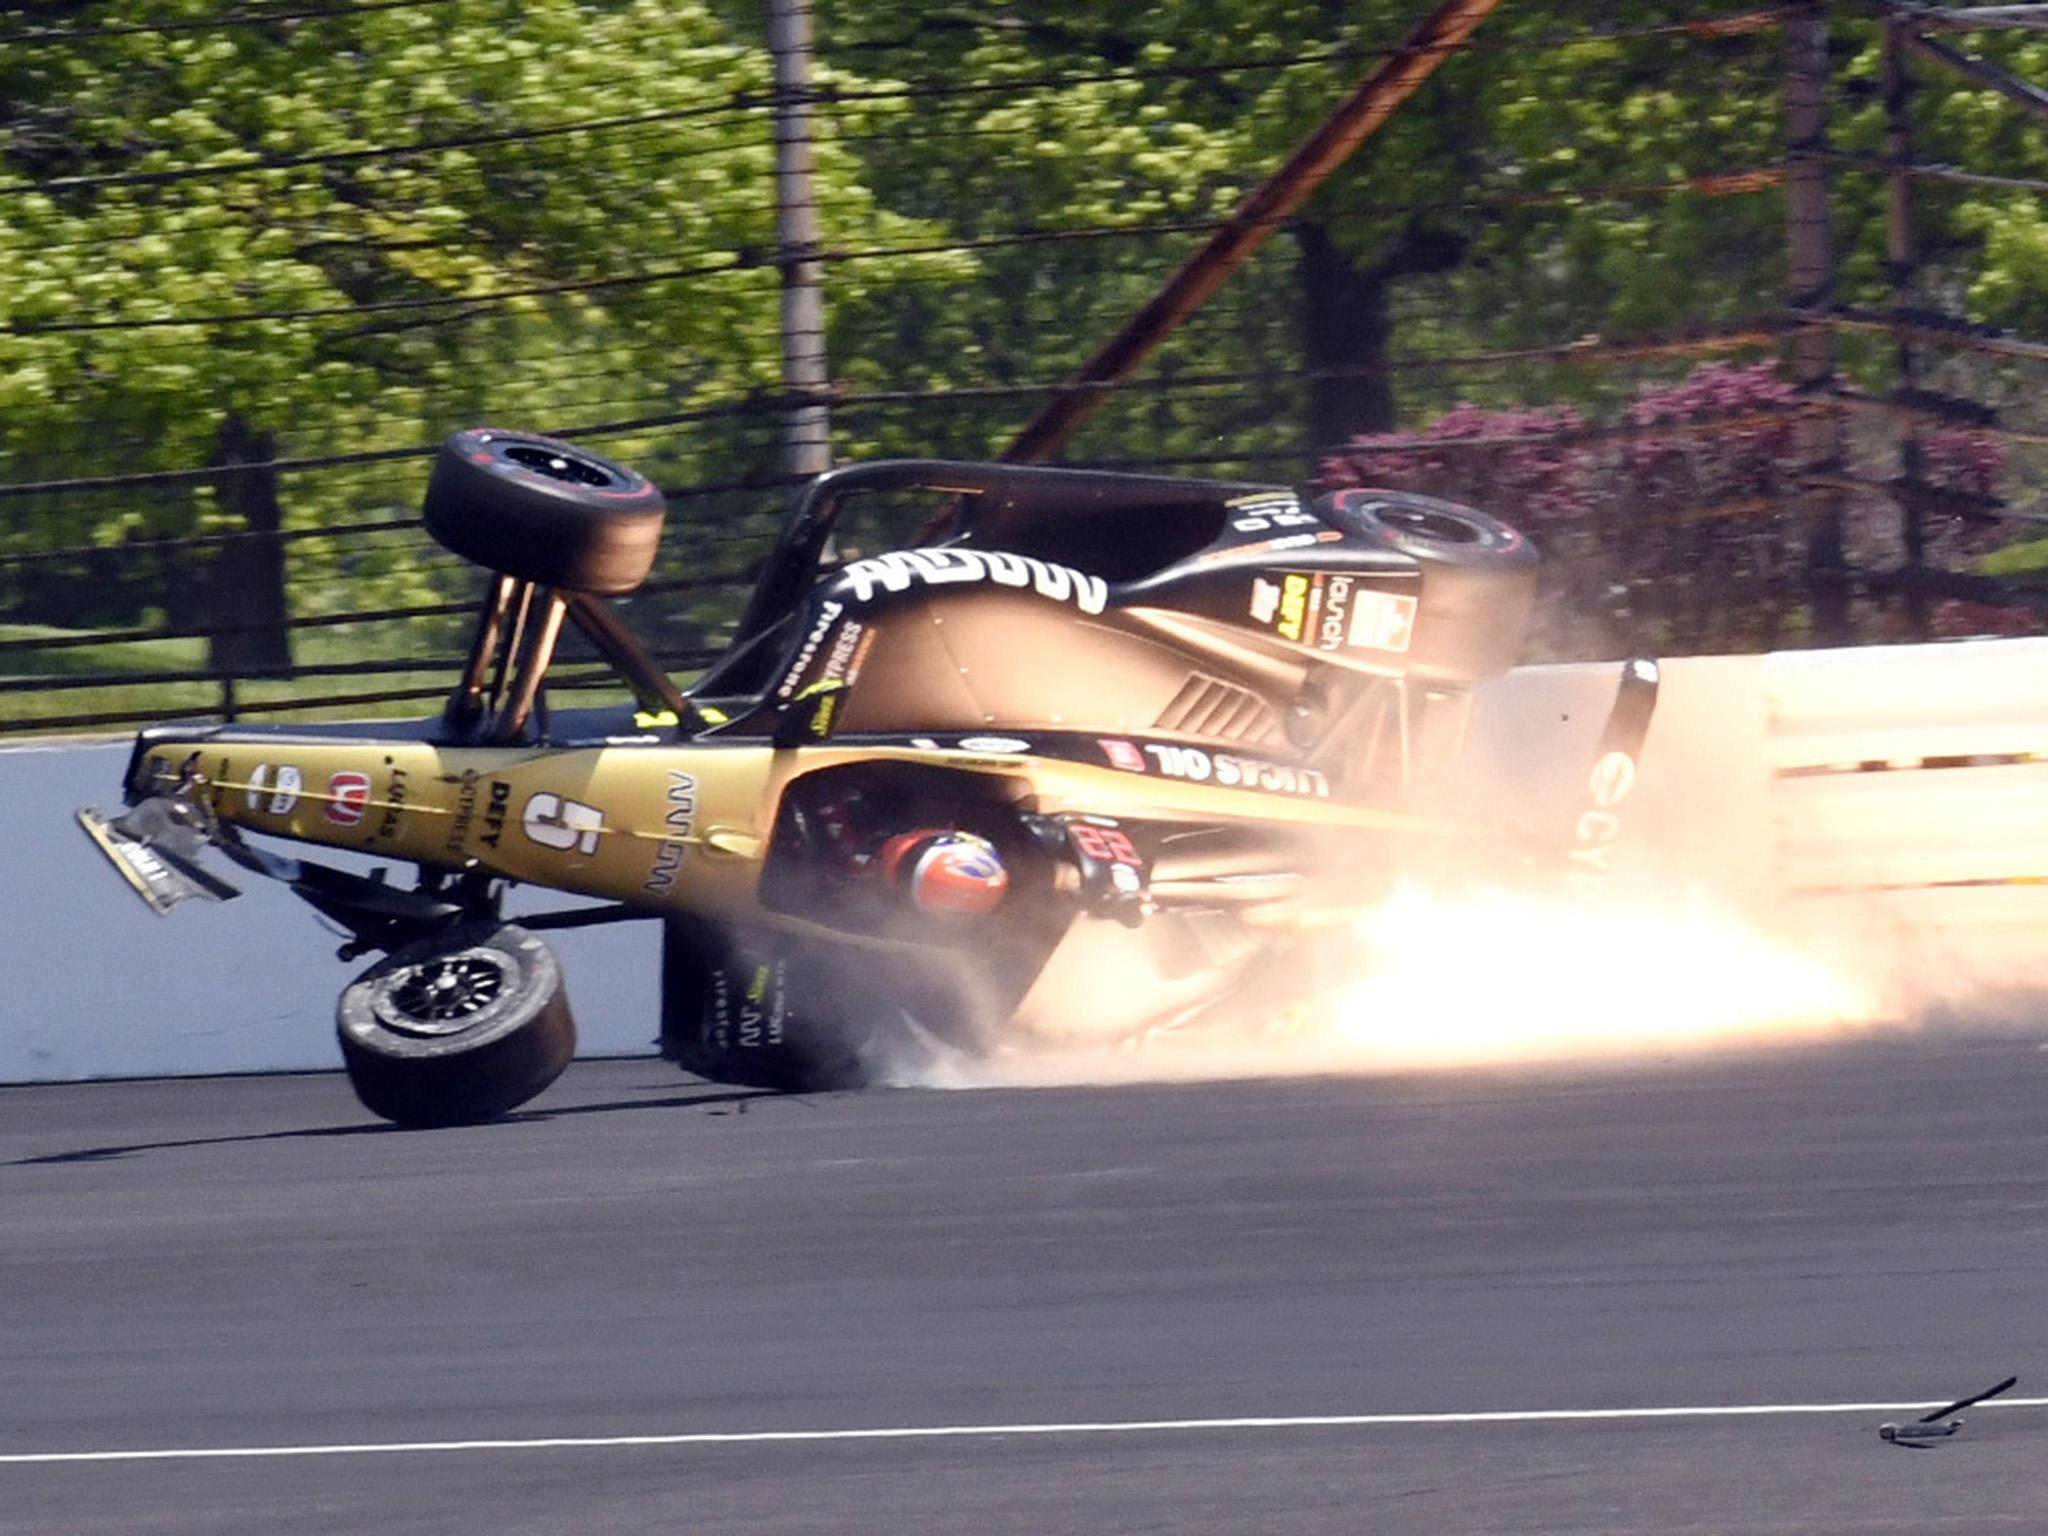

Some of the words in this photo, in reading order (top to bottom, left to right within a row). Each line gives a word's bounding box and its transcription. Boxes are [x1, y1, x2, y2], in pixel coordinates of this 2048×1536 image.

[1319, 576, 1355, 650] launch
[823, 620, 862, 684] YPRESS
[1144, 743, 1213, 780] OIL
[1213, 753, 1330, 798] LUCAS
[480, 781, 512, 849] DEFY
[523, 791, 605, 857] 5
[1068, 824, 1143, 867] 22
